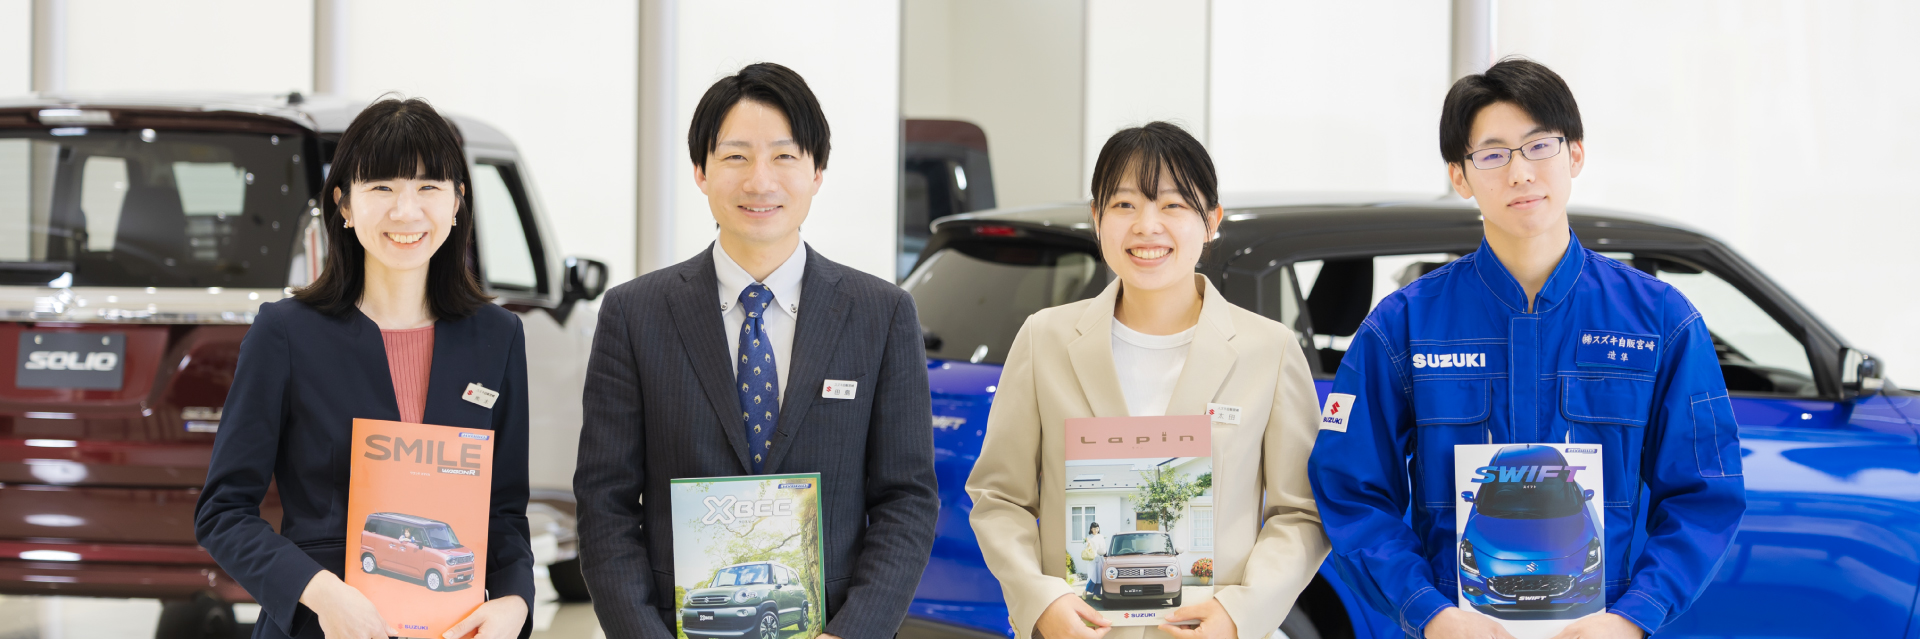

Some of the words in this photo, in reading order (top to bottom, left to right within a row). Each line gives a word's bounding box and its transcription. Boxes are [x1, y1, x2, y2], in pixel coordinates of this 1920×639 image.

[24, 350, 118, 371] SOLIO
[1412, 353, 1486, 368] SUZUKI
[1323, 416, 1343, 425] SUZUKI
[1080, 431, 1195, 445] Lapin
[363, 433, 482, 469] SMILE
[1470, 465, 1587, 483] SWIFT
[701, 495, 792, 525] XBEE
